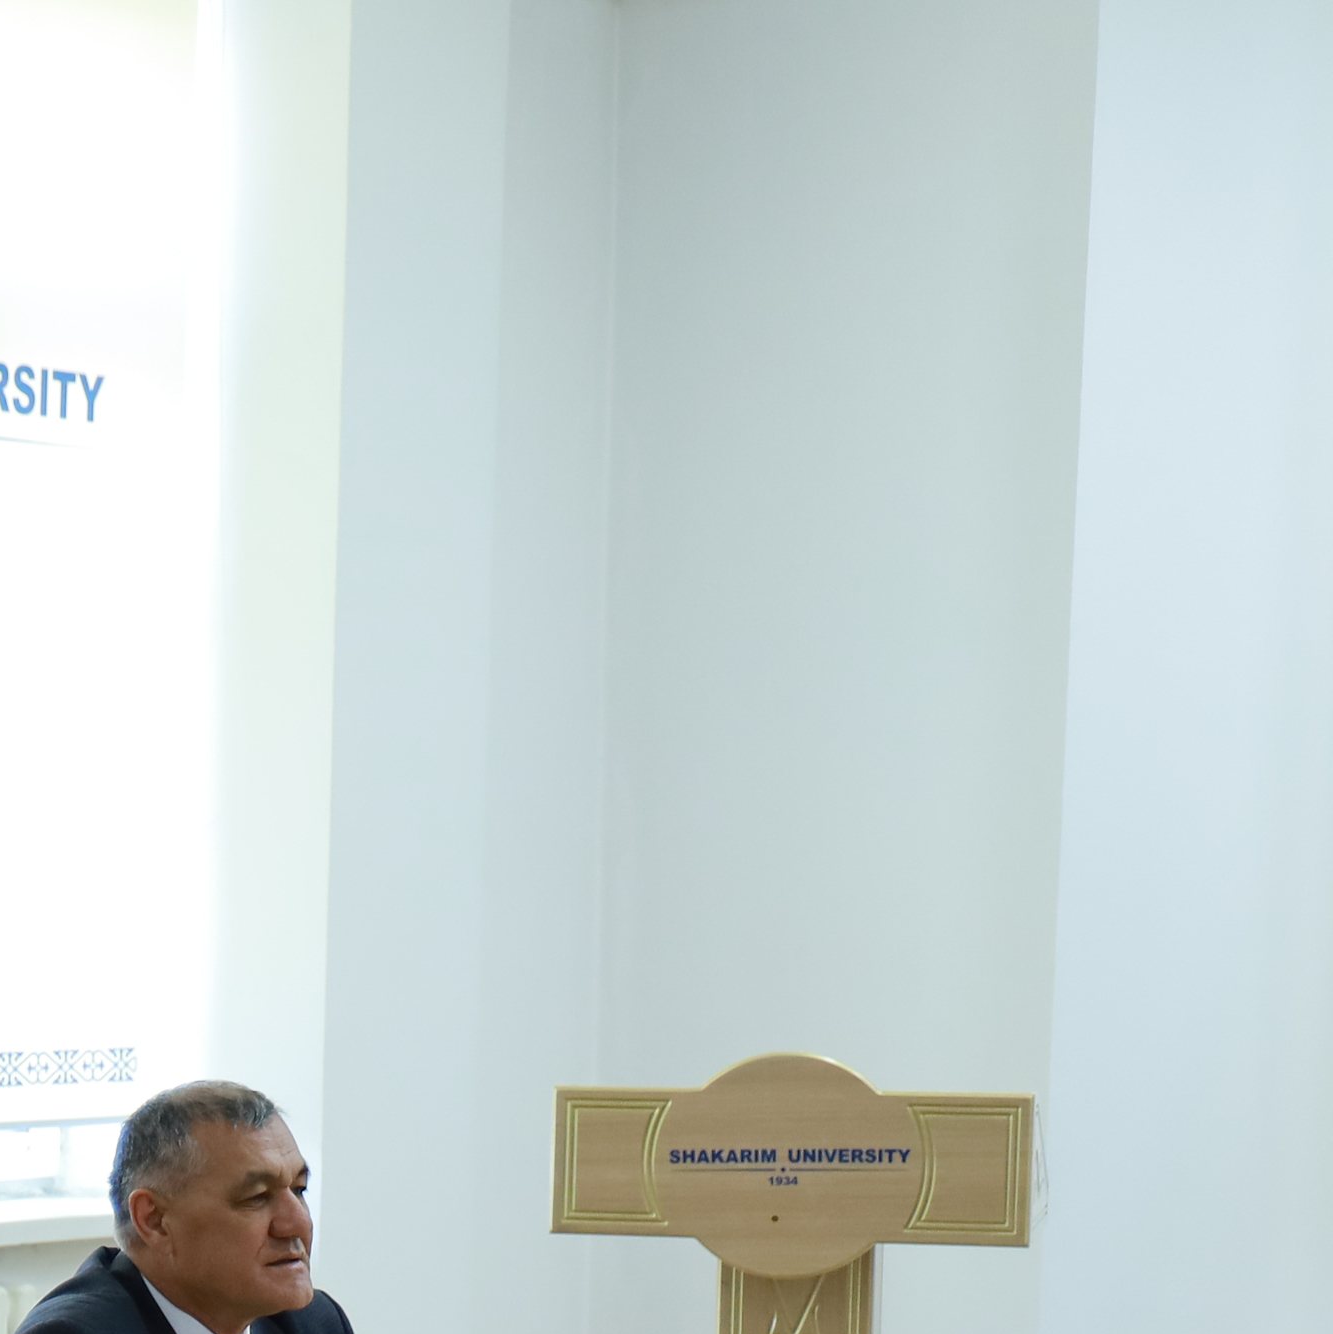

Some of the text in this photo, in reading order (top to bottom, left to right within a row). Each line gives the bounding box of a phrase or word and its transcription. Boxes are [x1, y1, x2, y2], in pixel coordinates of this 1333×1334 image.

[668, 1148, 911, 1165] SHAKARIM UNIVERSITY
[767, 1175, 799, 1187] 1934
